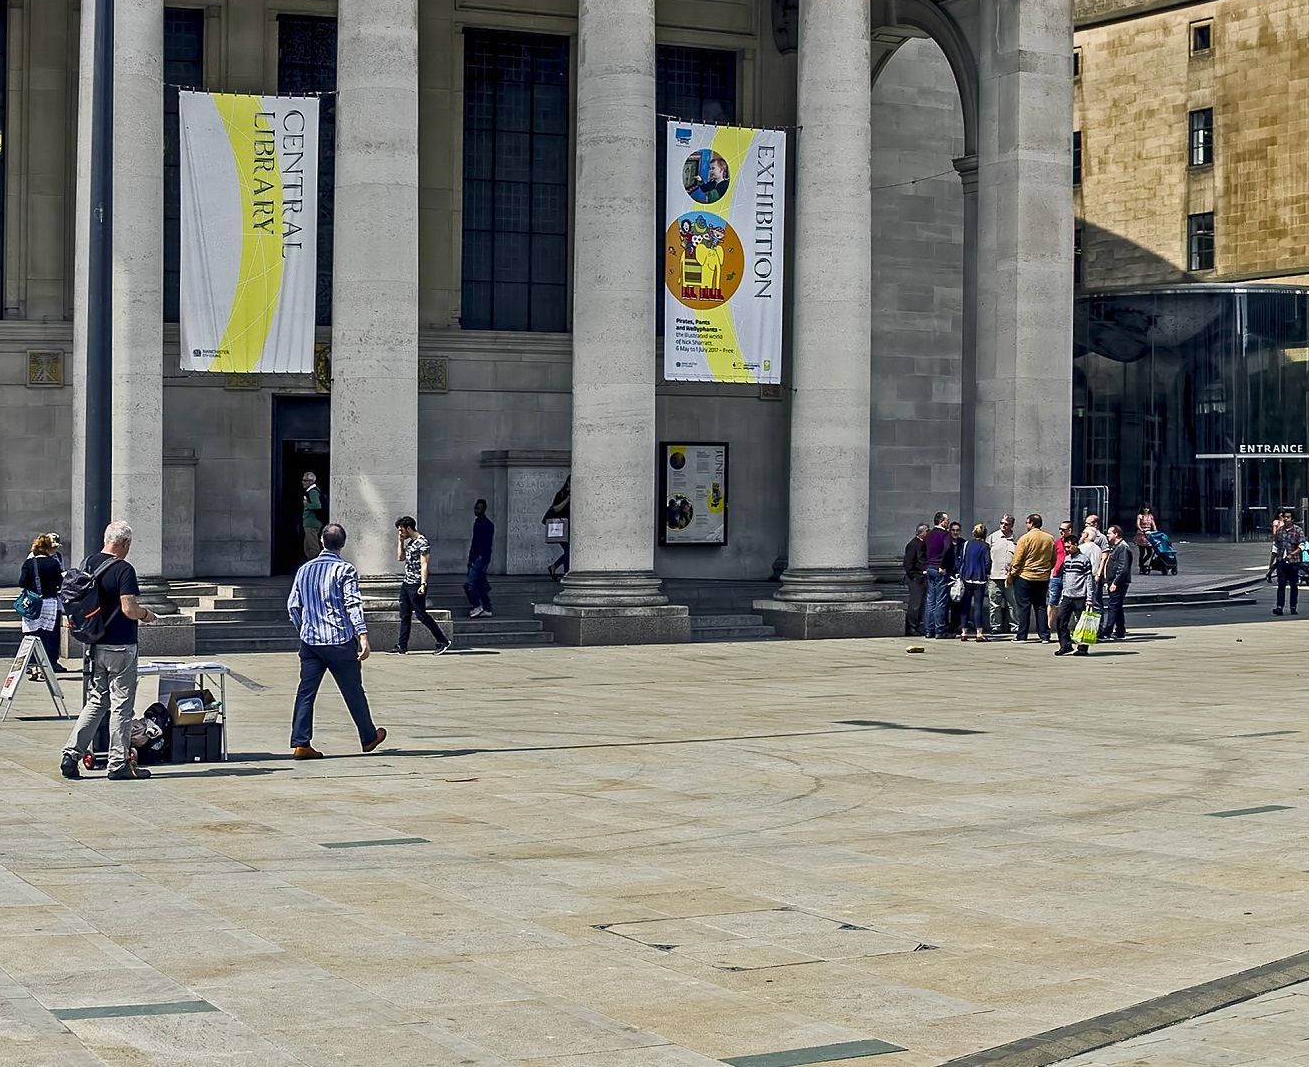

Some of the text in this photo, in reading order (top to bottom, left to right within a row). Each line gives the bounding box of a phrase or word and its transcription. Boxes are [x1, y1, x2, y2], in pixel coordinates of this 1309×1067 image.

[252, 111, 276, 235] LIBRARY
[281, 109, 306, 259] CENTRAL
[753, 144, 775, 300] EXHIBITION
[715, 449, 723, 478] JUNE
[1239, 444, 1303, 453] ENTRANCE
